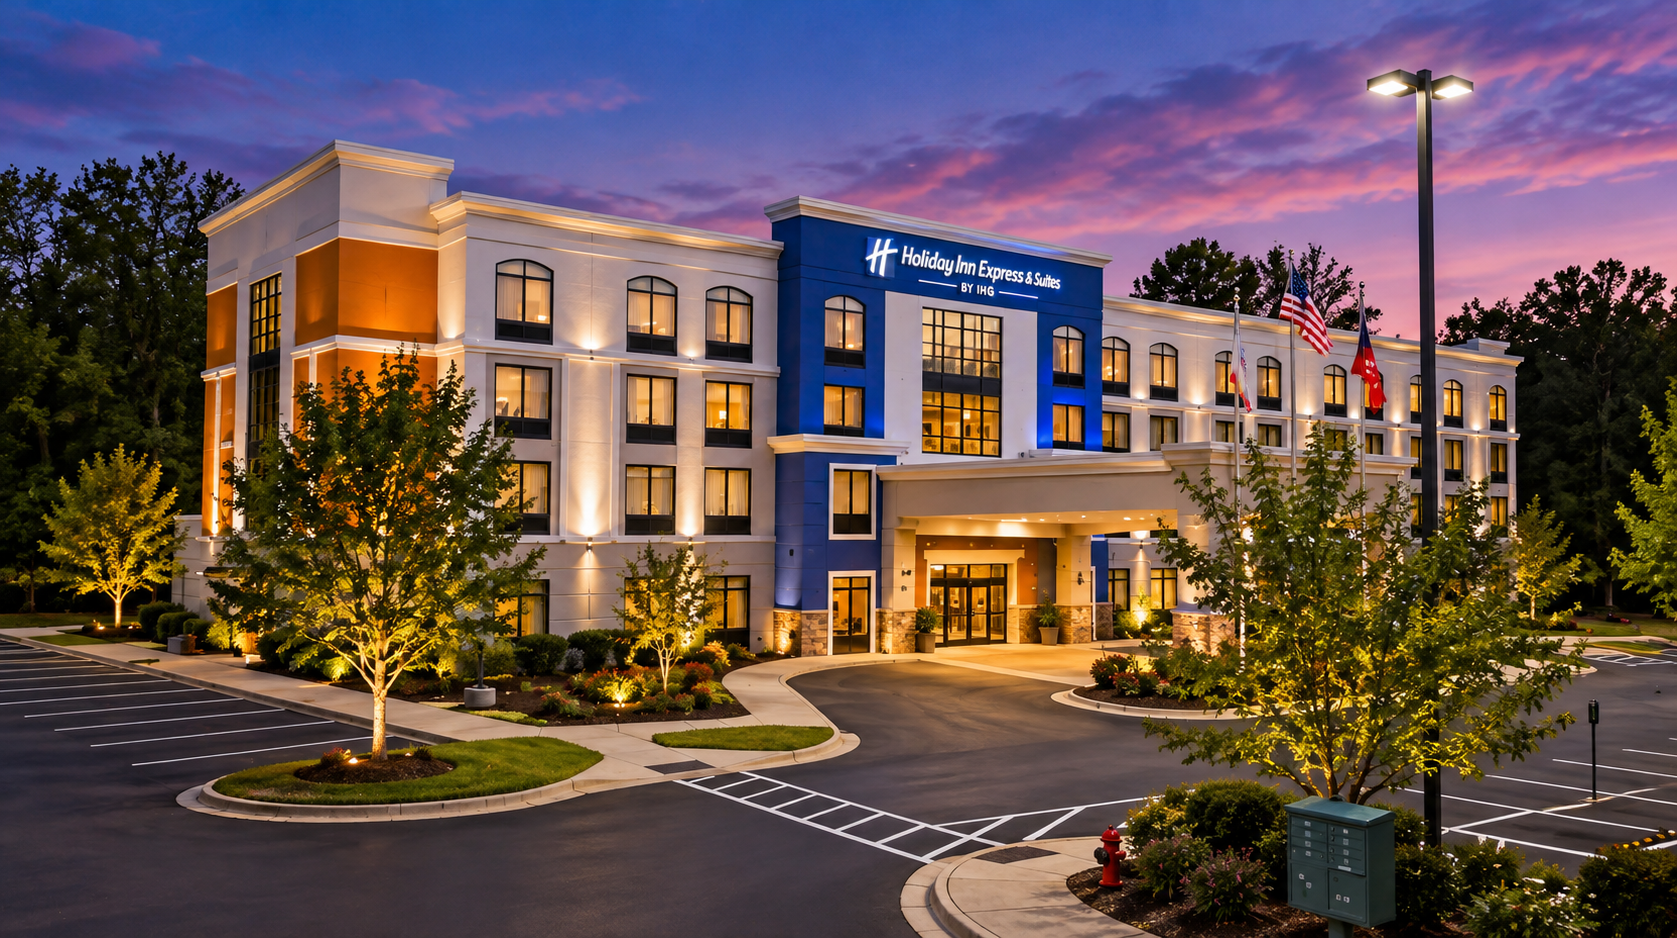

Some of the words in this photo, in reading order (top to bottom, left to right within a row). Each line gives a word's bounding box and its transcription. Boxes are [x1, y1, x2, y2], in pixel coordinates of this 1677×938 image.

[901, 245, 954, 277] Holiday
[955, 254, 976, 276] Inn
[979, 260, 1024, 283] Express
[1025, 271, 1033, 285] &
[1034, 272, 1061, 290] Suites
[961, 282, 973, 294] BY
[976, 284, 995, 297] IHG
